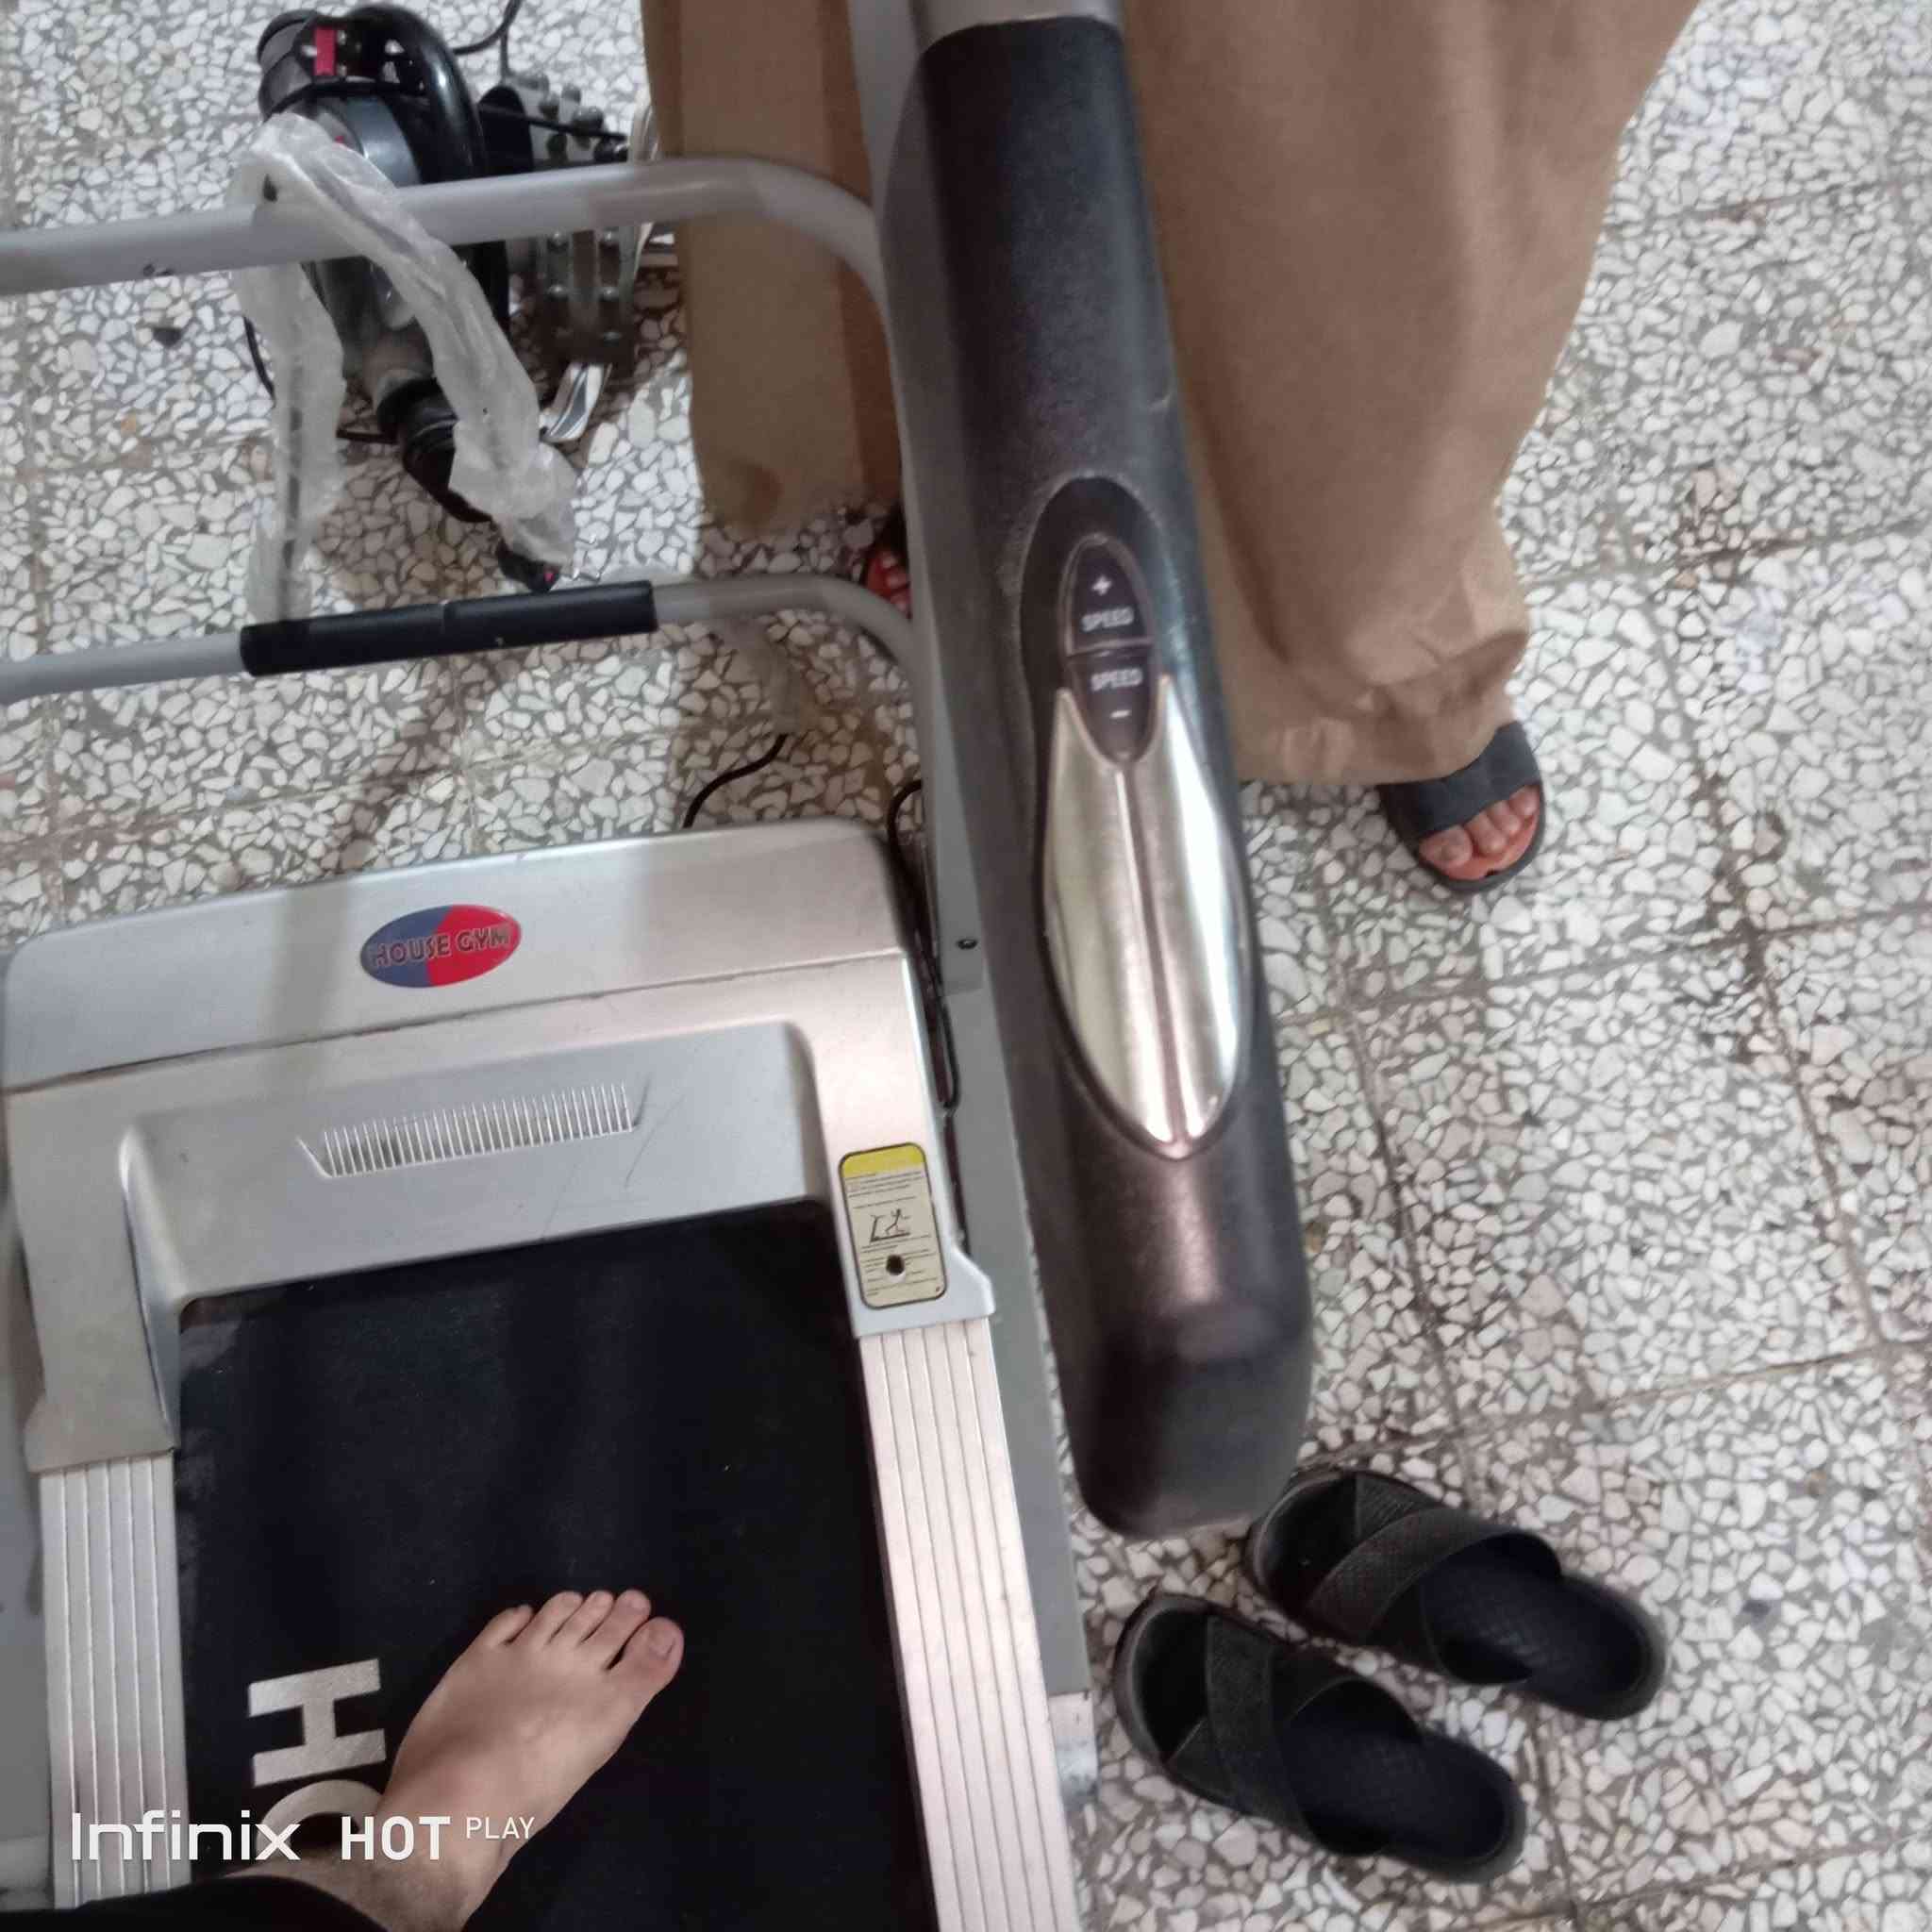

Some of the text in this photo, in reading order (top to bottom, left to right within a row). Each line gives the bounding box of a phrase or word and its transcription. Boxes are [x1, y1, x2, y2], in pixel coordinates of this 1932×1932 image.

[1081, 607, 1133, 631] SPEED
[1091, 668, 1142, 691] SPEED
[370, 922, 511, 968] HOUSE GYM
